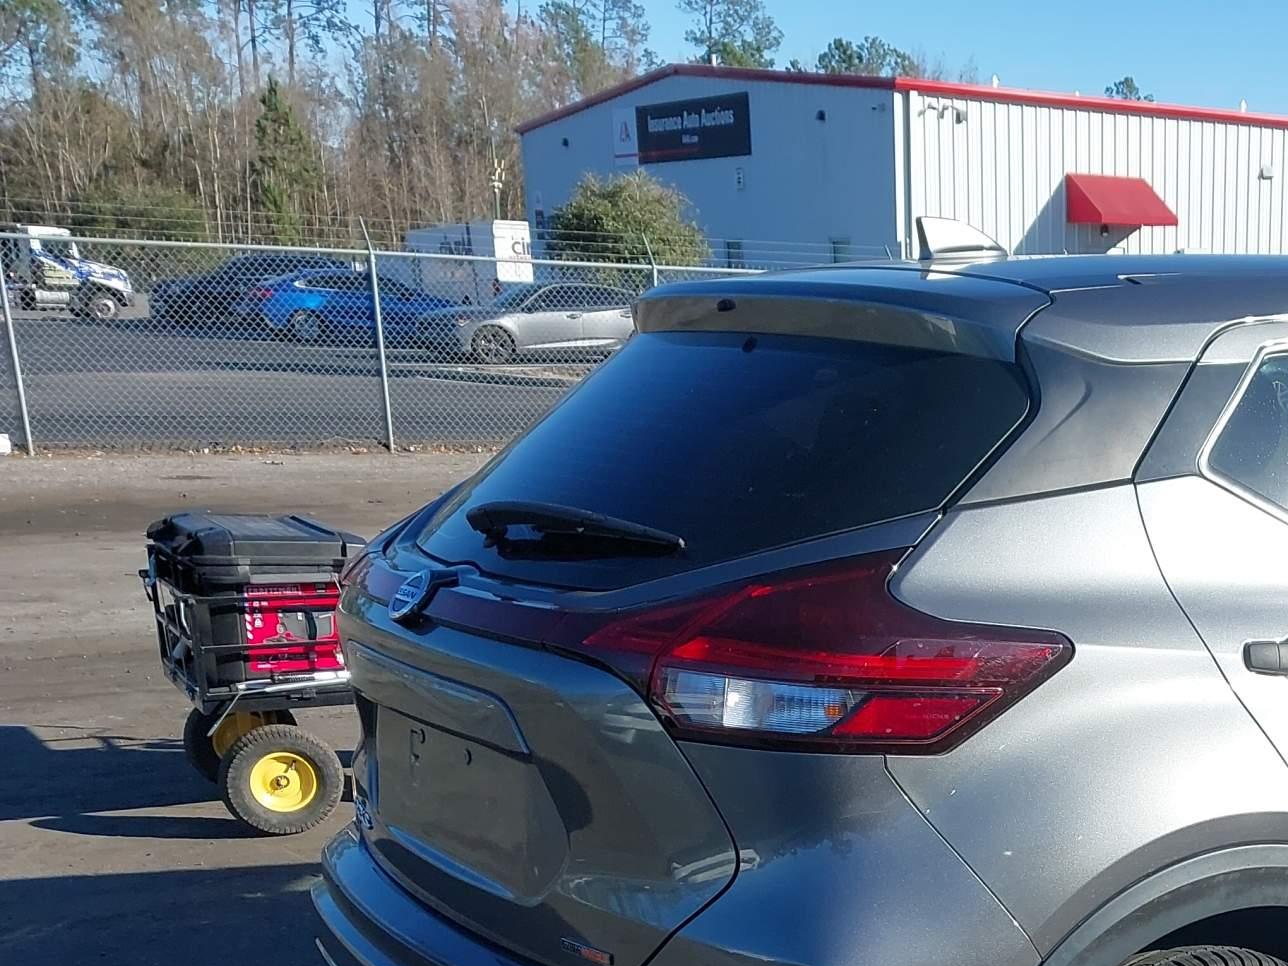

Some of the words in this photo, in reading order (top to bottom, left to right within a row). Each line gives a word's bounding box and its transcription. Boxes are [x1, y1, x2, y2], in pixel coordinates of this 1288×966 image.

[647, 114, 682, 133] Insurance
[682, 110, 700, 129] Auto
[700, 106, 734, 128] Auctions
